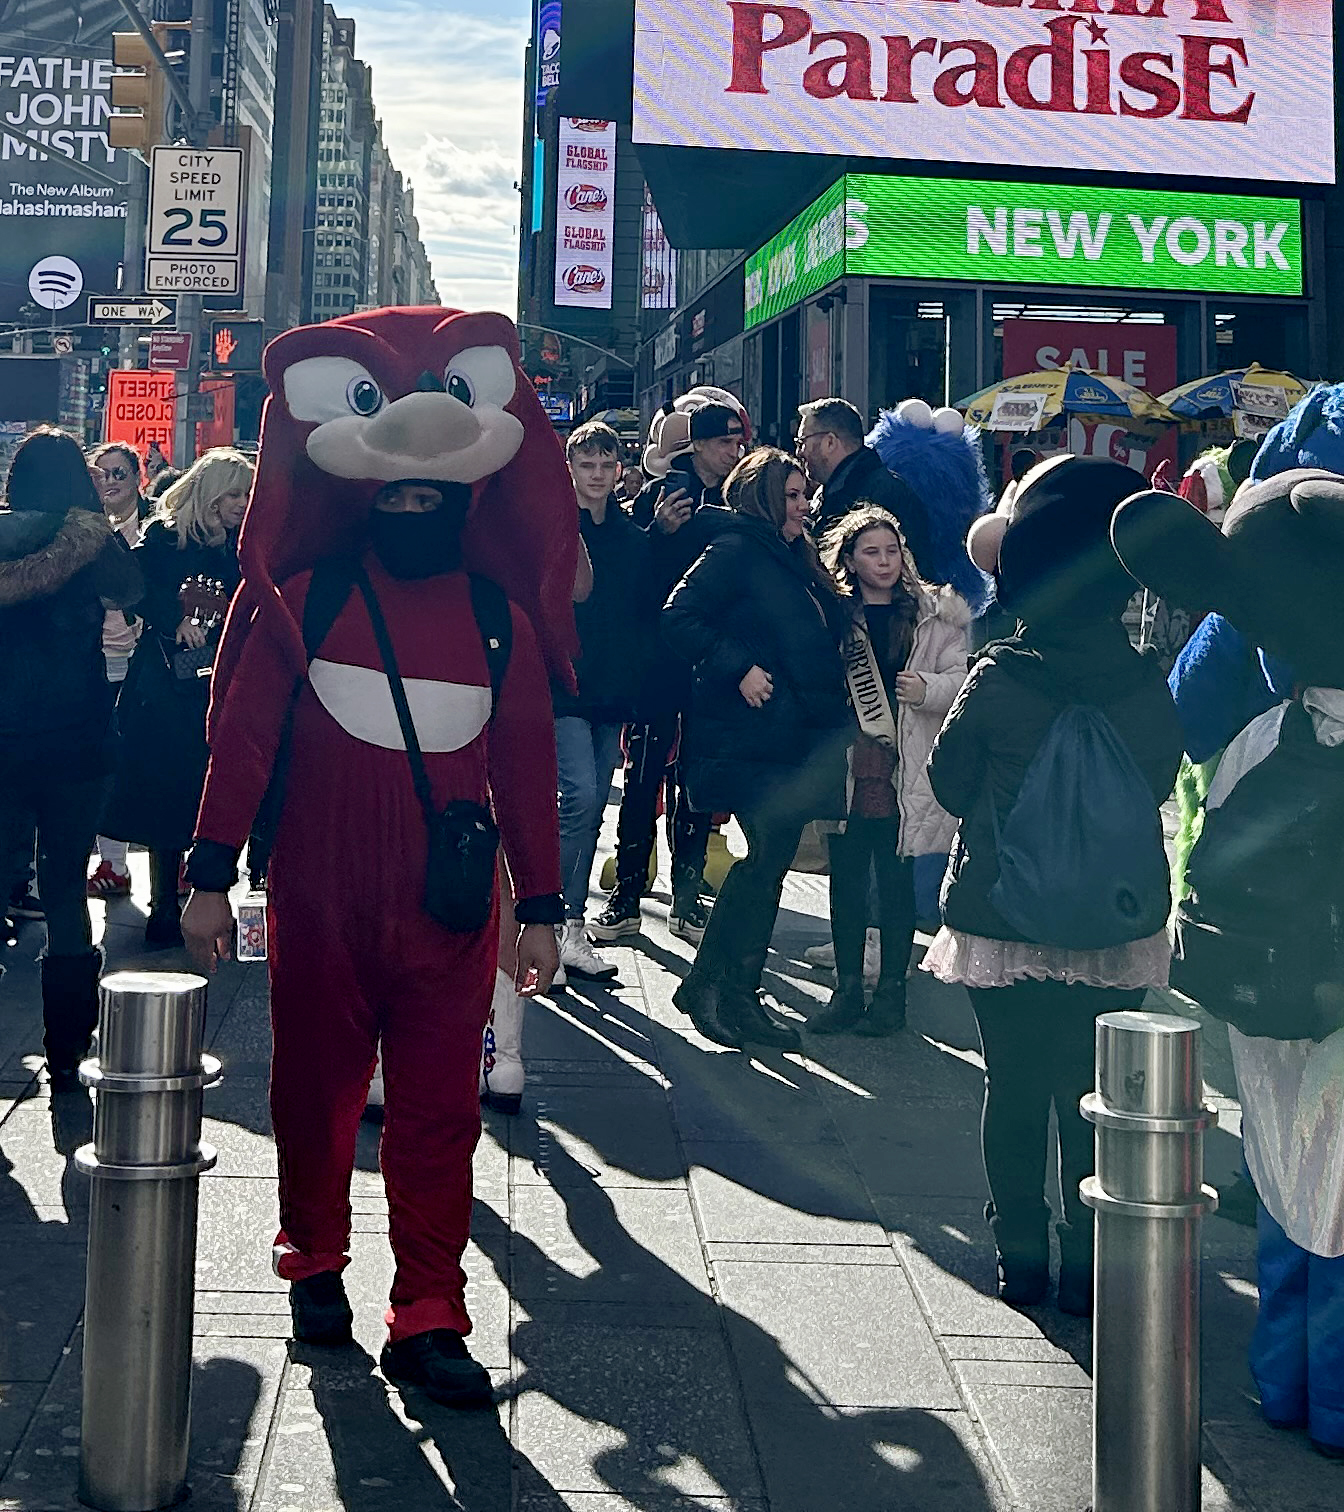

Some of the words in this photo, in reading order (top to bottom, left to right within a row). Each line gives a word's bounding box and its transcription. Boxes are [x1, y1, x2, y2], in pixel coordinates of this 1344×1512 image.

[5, 93, 112, 126] JOHN
[1, 130, 118, 163] MISTY
[566, 144, 608, 161] GLOBAL
[178, 155, 214, 168] CITY
[565, 158, 609, 172] FLAGSHIP
[169, 171, 222, 185] SPEED
[9, 182, 35, 196] The
[37, 183, 68, 197] New
[69, 184, 114, 198] Album
[174, 189, 216, 202] LIMIT
[161, 207, 229, 248] 25
[564, 225, 606, 241] GLOBAL
[563, 239, 607, 253] FLAGSHIP
[965, 205, 1113, 263] NEW
[1128, 214, 1291, 272] YORK
[170, 263, 216, 275] PHOTO
[155, 275, 230, 289] ENFORCED
[102, 305, 126, 318] ONE
[138, 306, 164, 318] WAY
[1035, 346, 1147, 387] SALE
